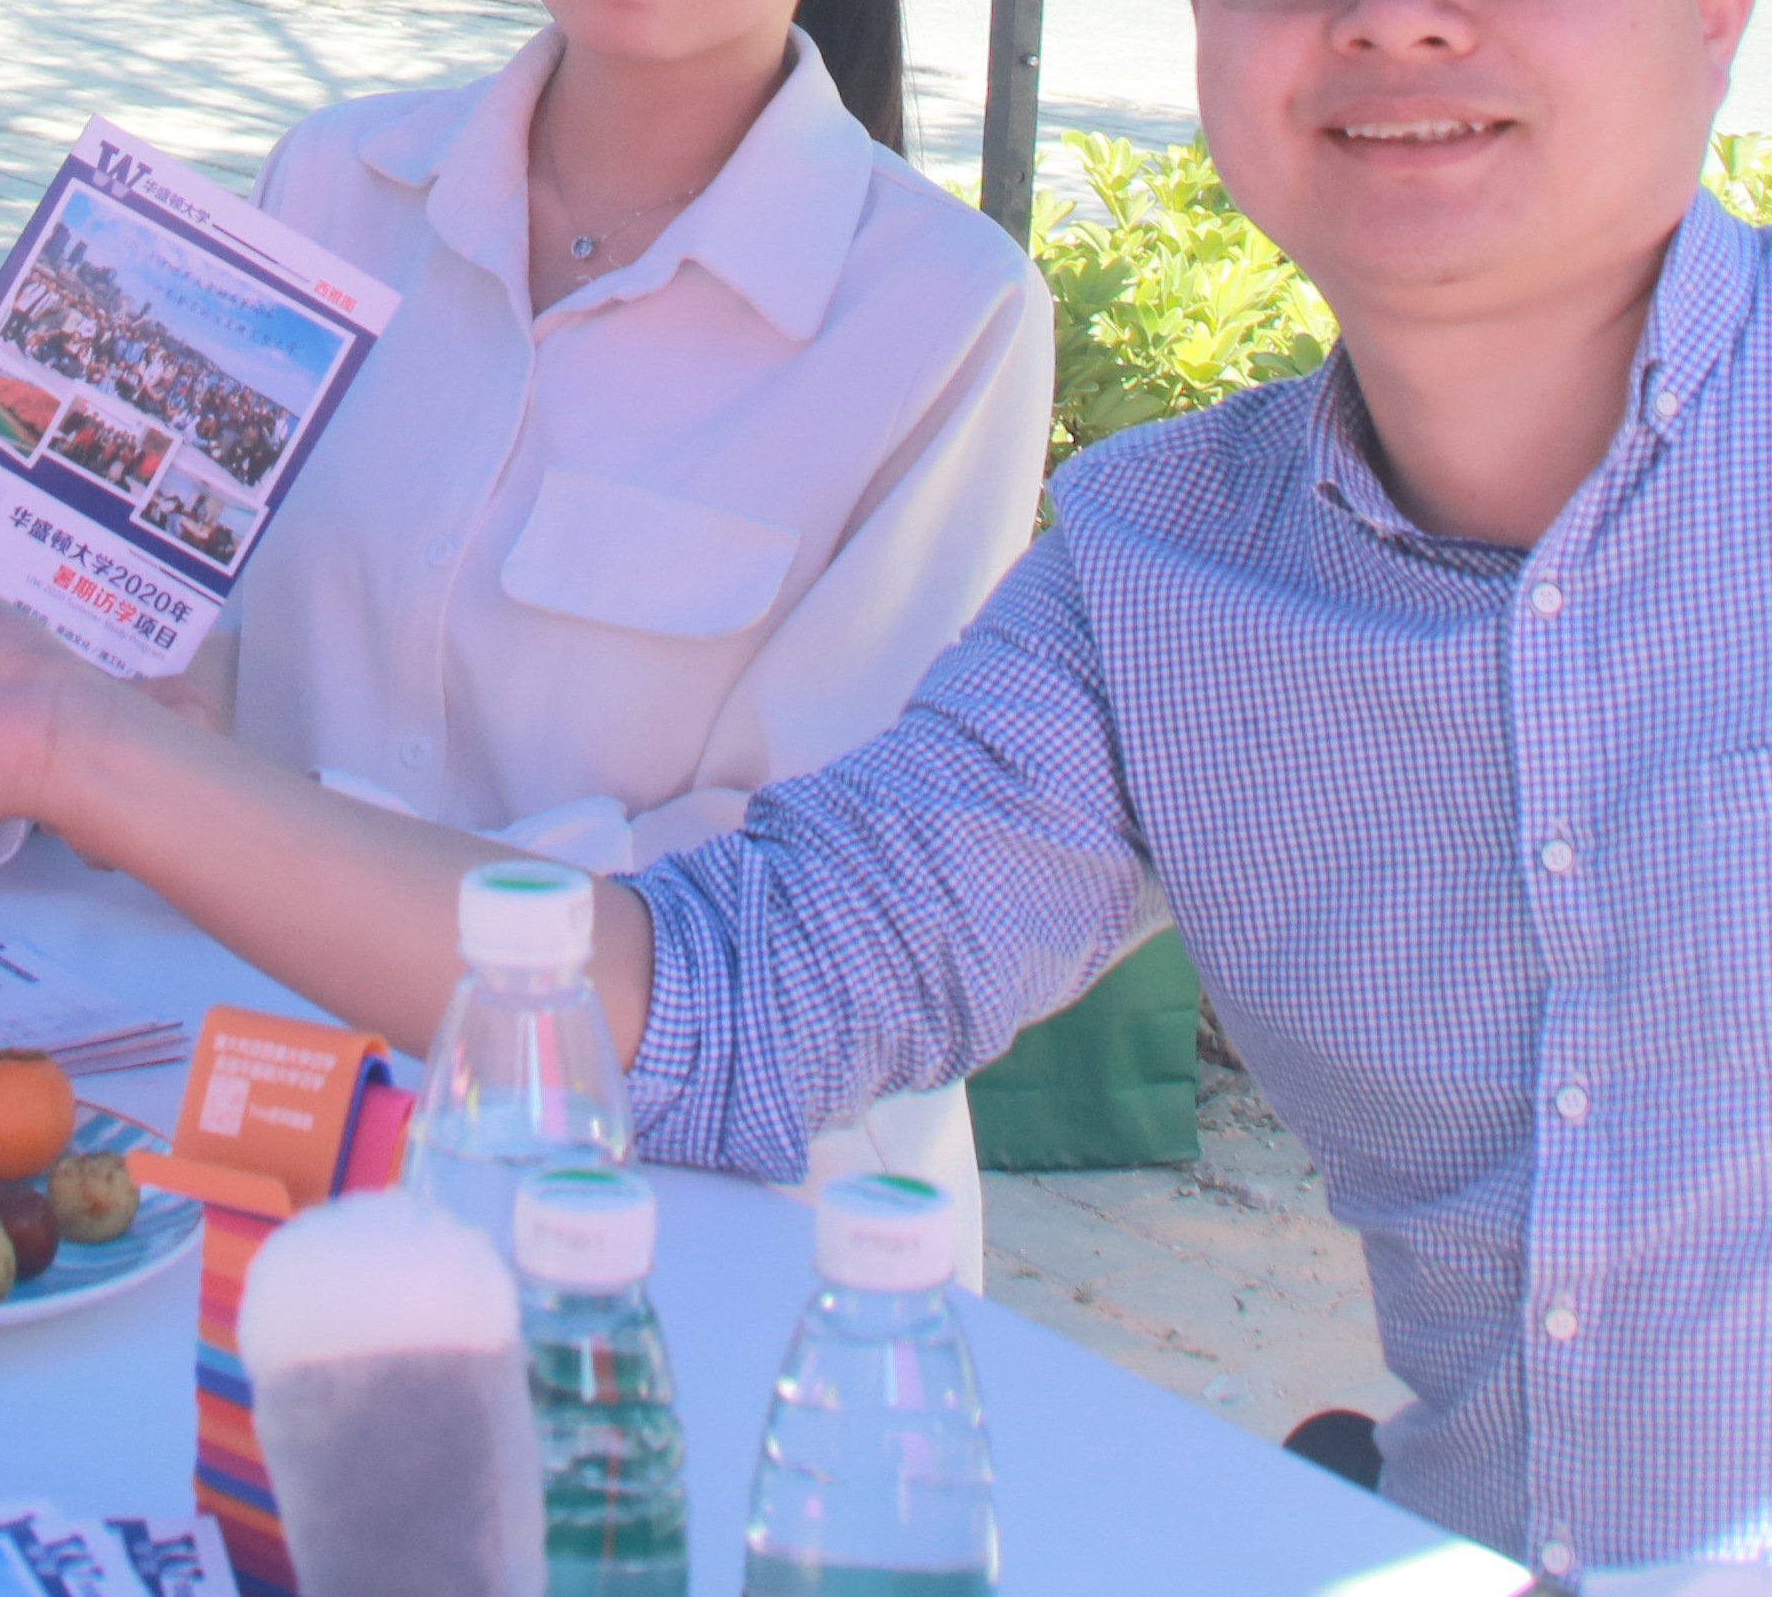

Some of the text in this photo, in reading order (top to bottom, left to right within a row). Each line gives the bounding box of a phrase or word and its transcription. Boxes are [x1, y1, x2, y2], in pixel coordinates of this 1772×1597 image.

[90, 139, 153, 202] W
[140, 176, 212, 228] 华盛顿大学
[5, 502, 194, 626] 华盛顿大学2020年
[49, 562, 179, 651] 暑期访学项目
